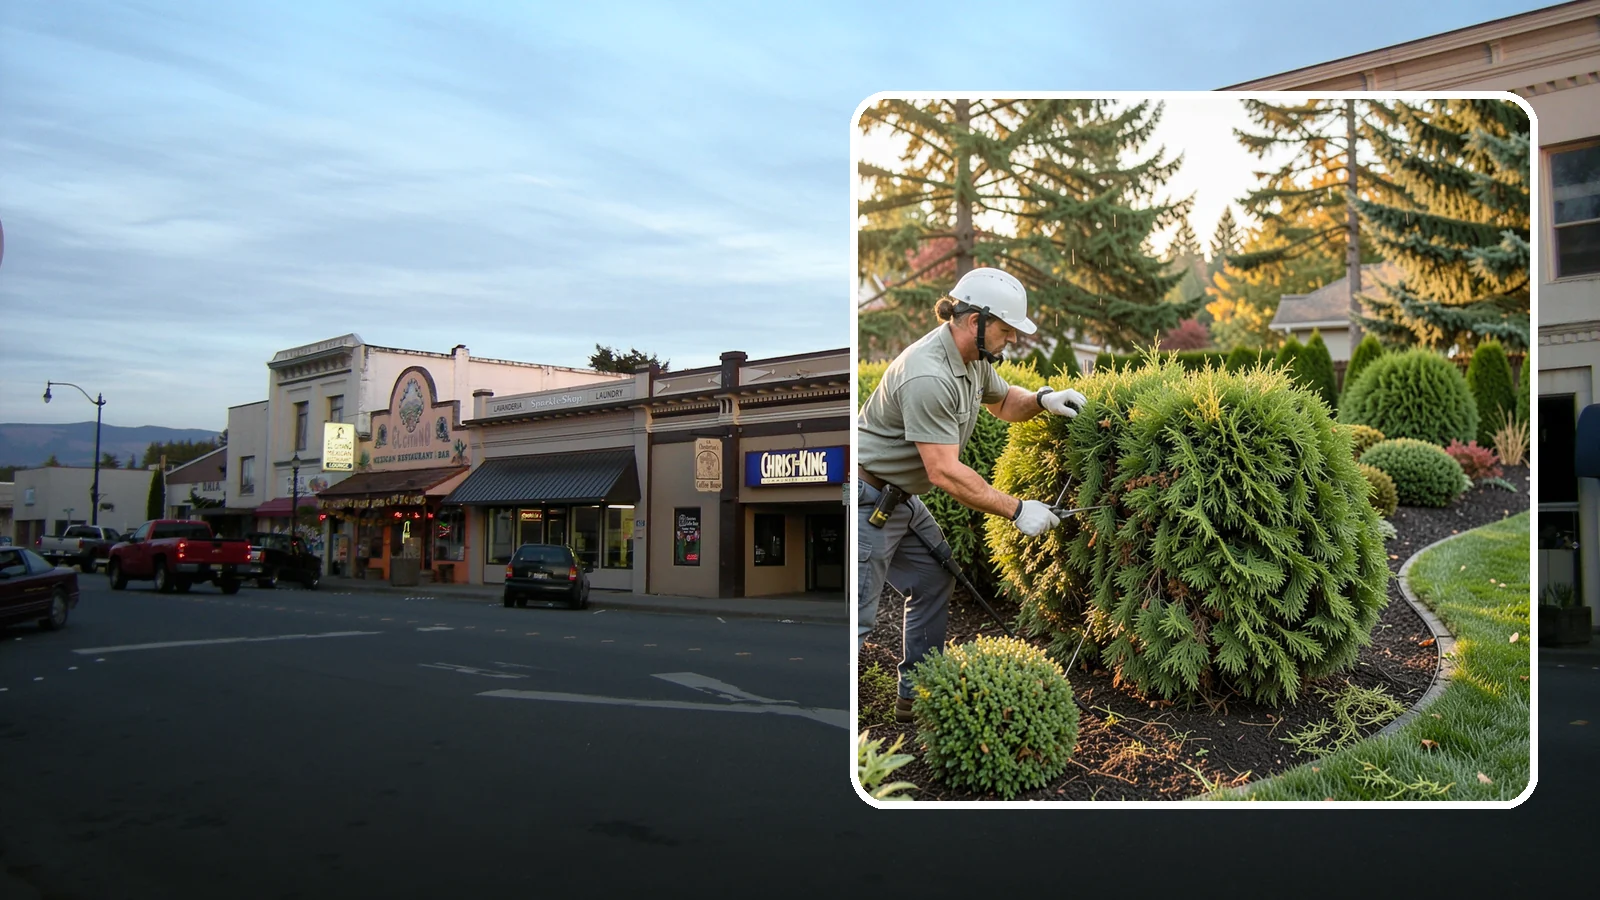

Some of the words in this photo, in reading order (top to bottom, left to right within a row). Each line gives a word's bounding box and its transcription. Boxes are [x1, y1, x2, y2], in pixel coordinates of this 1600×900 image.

[595, 388, 624, 399] LAUNDRY
[493, 402, 522, 412] LAVANDERIA
[373, 454, 396, 464] MEXICAN
[397, 451, 434, 462] RESTAURANT
[437, 450, 450, 459] BAR
[761, 452, 797, 478] CHRIST
[799, 450, 827, 476] KING
